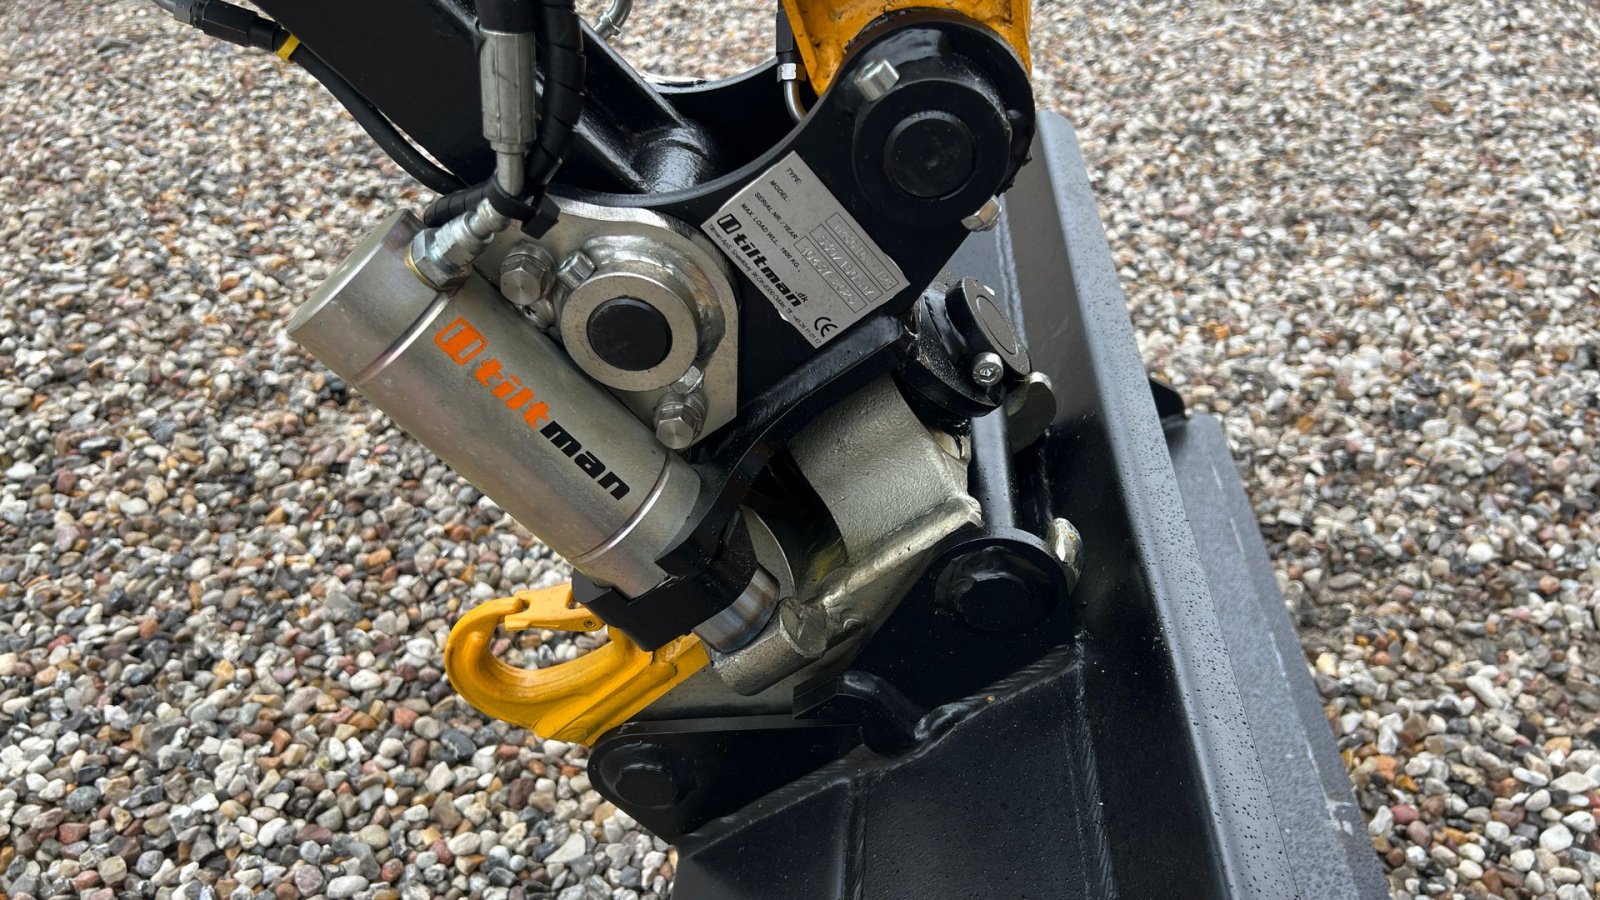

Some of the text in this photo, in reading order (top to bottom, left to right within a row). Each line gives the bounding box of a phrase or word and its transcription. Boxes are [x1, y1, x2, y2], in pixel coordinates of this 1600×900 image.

[753, 217, 768, 233] LOAD
[784, 224, 798, 239] YEAR
[733, 234, 802, 308] tiltman
[814, 317, 838, 338] CE
[474, 358, 631, 501] tiltman
